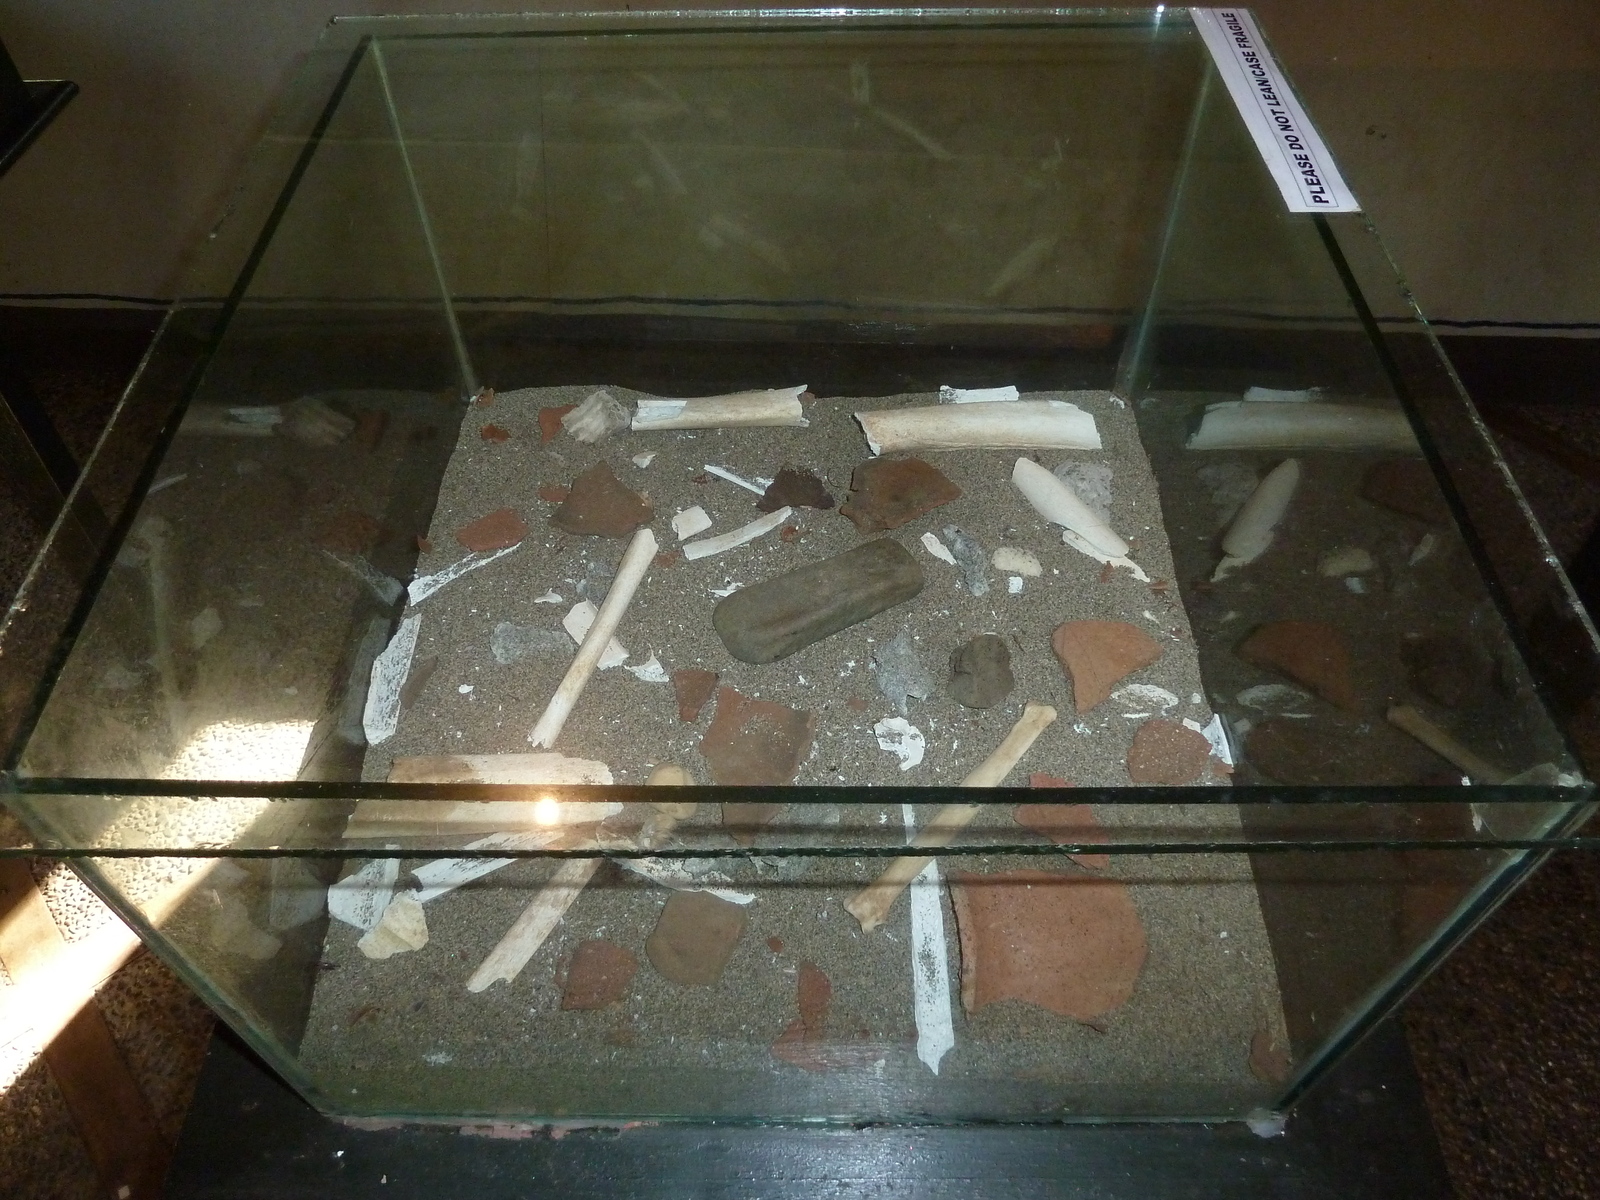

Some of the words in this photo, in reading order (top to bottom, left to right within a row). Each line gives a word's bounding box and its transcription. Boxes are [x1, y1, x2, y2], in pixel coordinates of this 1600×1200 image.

[1222, 12, 1252, 49] FRAGILE
[1270, 109, 1294, 132] NOT
[1284, 135, 1304, 150] DO
[1294, 154, 1329, 204] PLEASE
